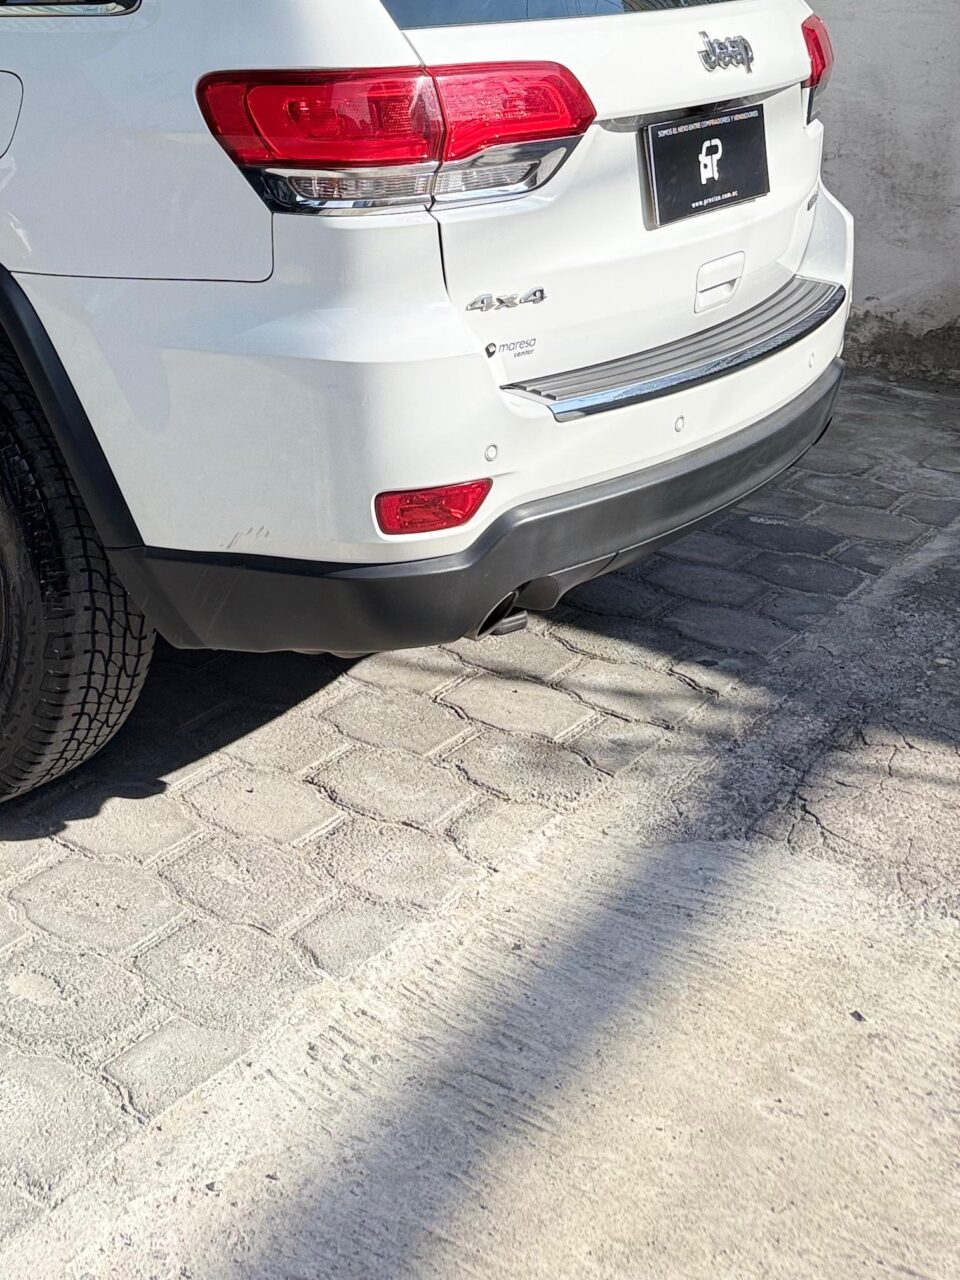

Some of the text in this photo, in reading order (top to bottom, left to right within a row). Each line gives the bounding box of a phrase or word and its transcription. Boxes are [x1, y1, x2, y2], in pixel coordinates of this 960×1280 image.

[697, 30, 754, 74] Jeep
[498, 338, 537, 352] maresa
[513, 348, 535, 358] center
